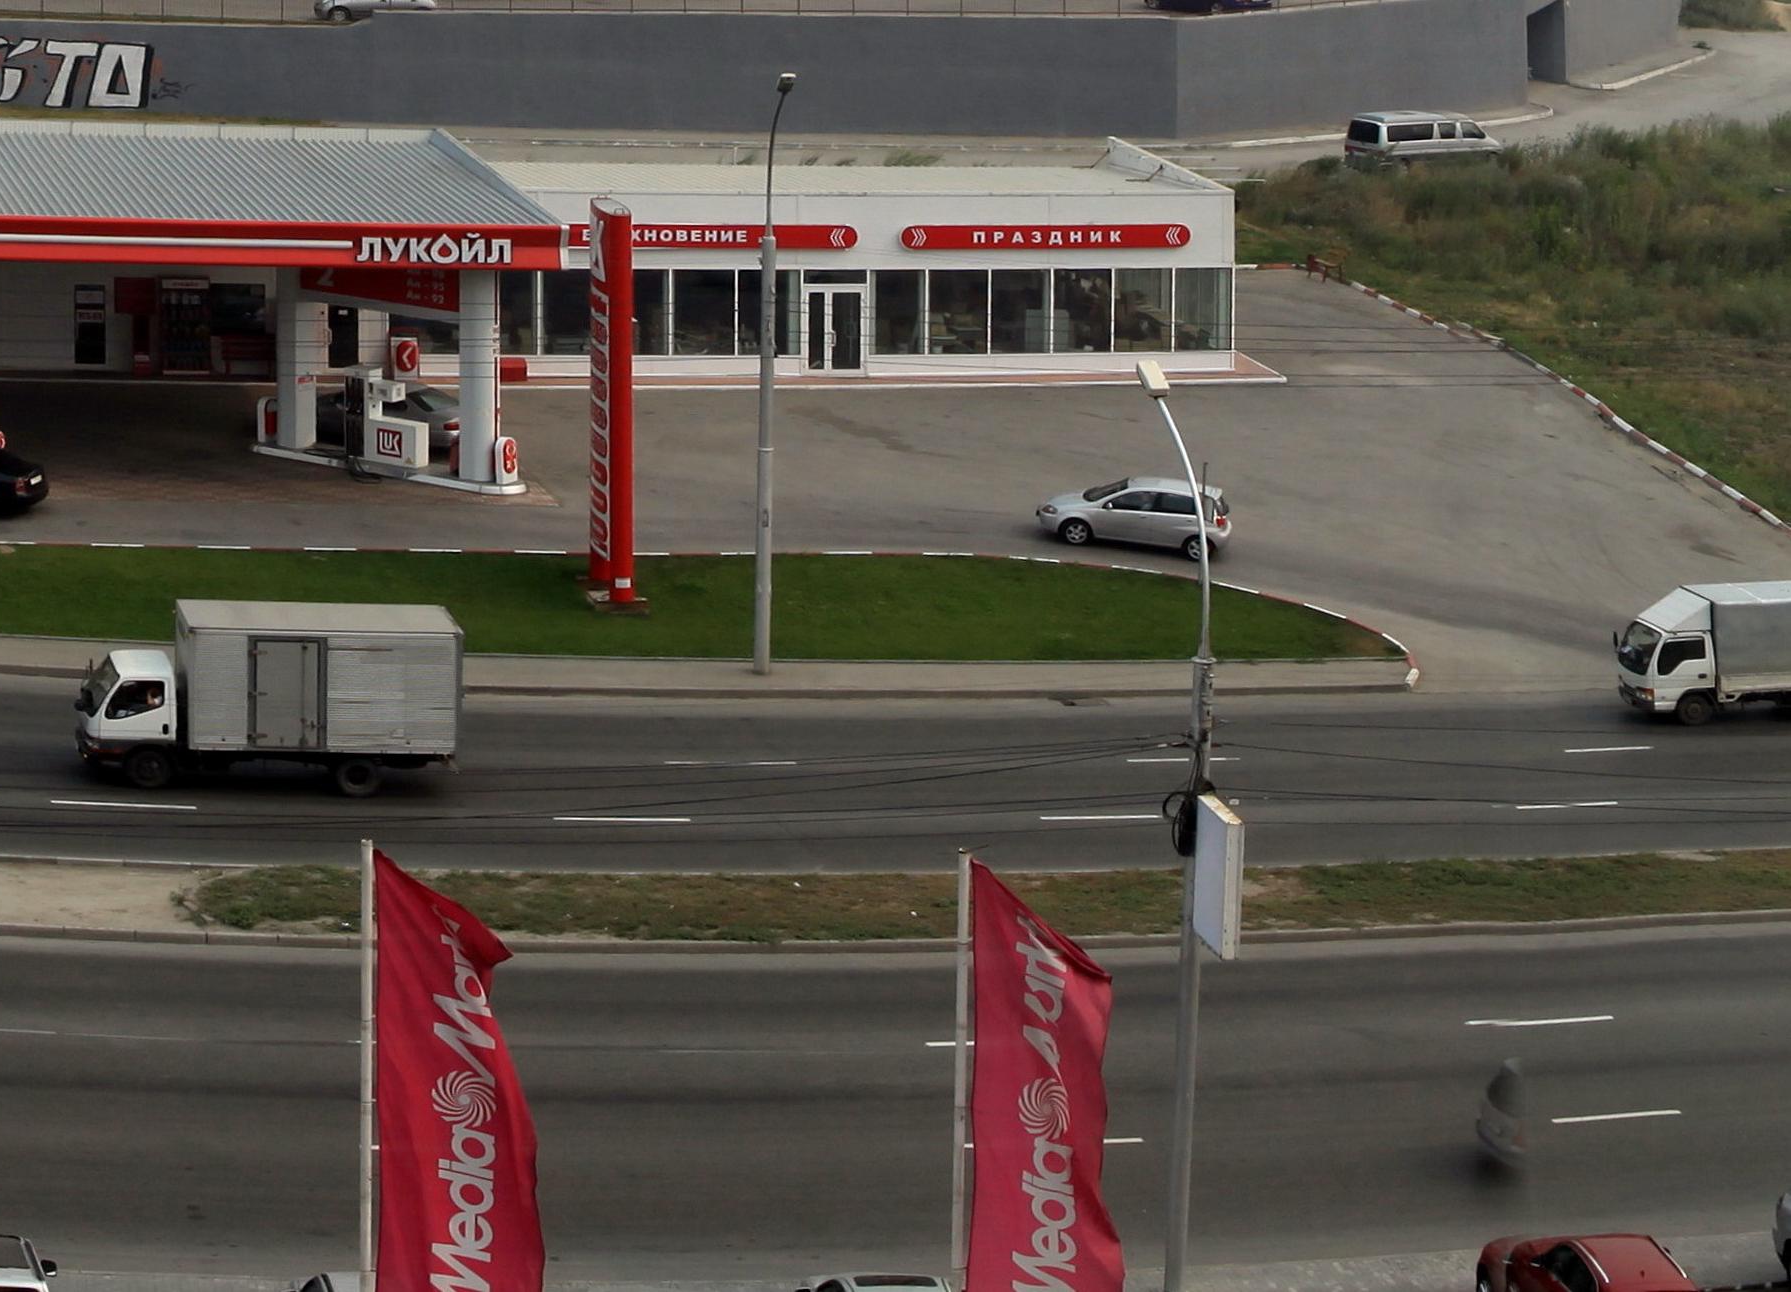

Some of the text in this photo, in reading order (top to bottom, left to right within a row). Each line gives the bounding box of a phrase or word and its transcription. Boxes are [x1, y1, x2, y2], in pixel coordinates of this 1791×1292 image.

[582, 229, 748, 243] ВХНОВЕНИЕ
[972, 230, 1122, 245] ПРАЗДНИК
[356, 232, 512, 264] ЛУКОЙЛ
